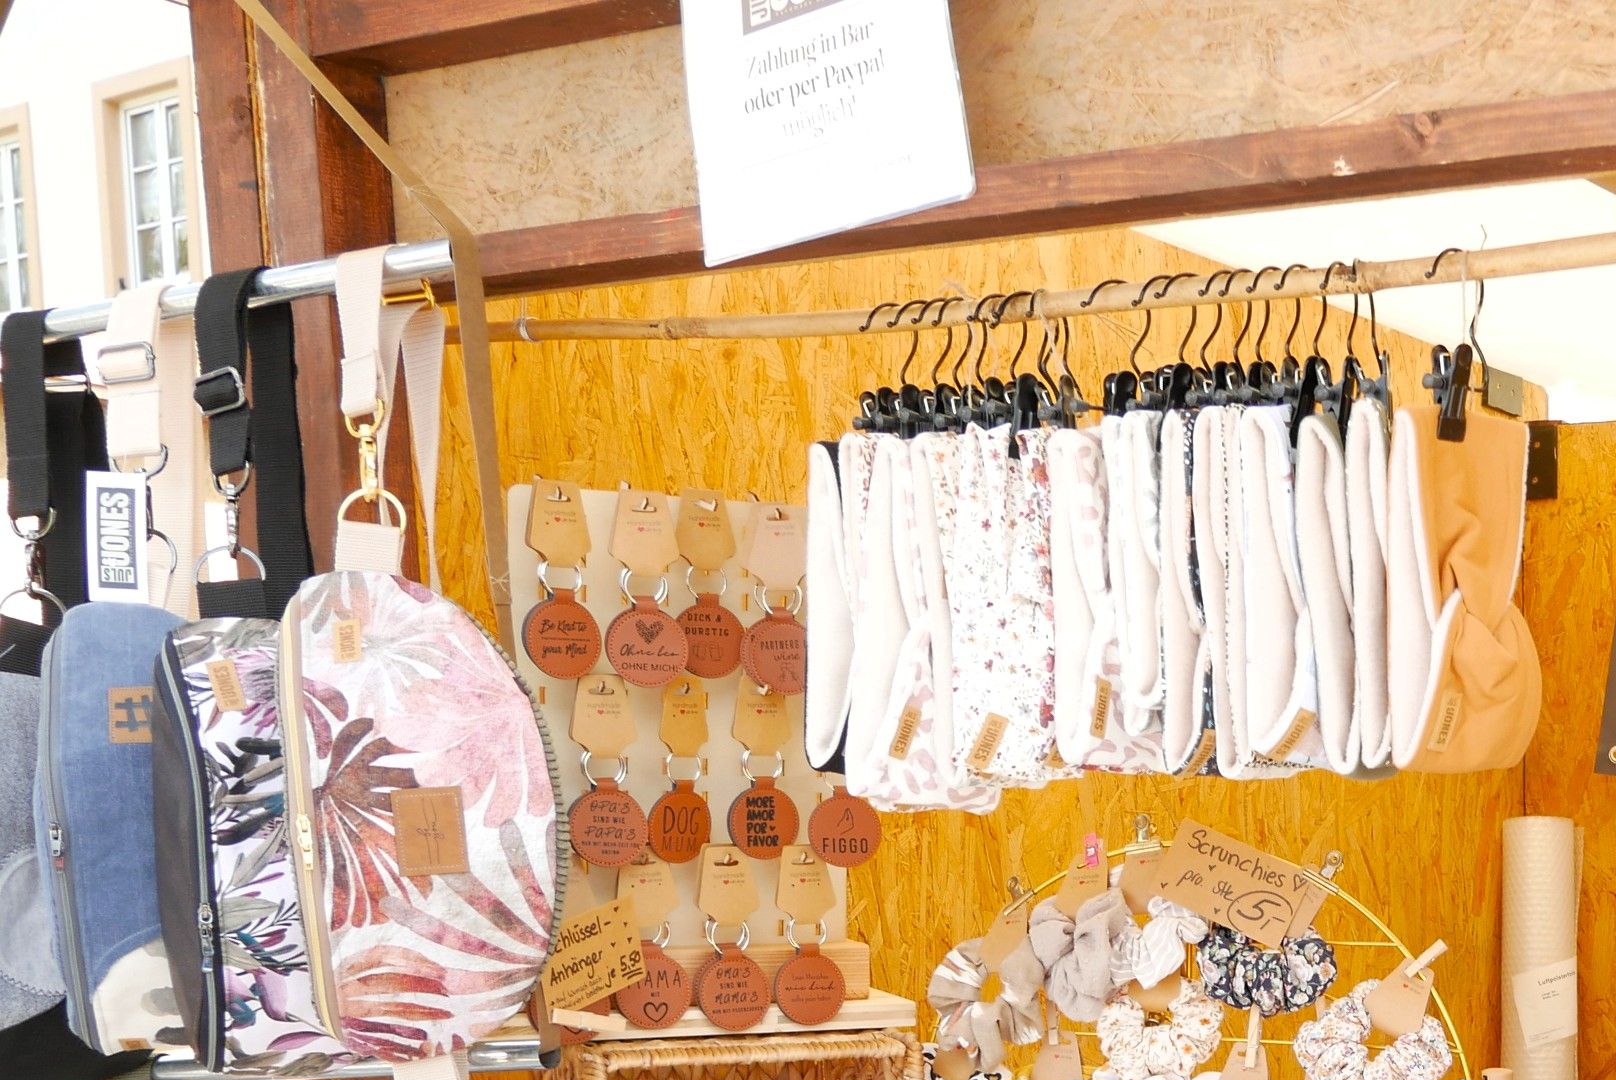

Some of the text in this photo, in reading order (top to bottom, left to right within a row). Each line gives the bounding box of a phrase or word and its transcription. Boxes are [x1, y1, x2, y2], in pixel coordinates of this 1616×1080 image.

[746, 21, 875, 79] Zahlung in Bar
[744, 48, 886, 115] oder per Paypal
[687, 612, 713, 623] DICK
[685, 626, 730, 637] DURSTIG
[621, 661, 649, 672] OHNE
[746, 795, 776, 809] MORE
[663, 805, 701, 836] DOG
[746, 822, 768, 834] POR
[746, 834, 780, 849] FAVOR
[822, 836, 869, 854] FIGGO
[1187, 829, 1286, 888] Scrunchies
[550, 950, 603, 987] Anhänger
